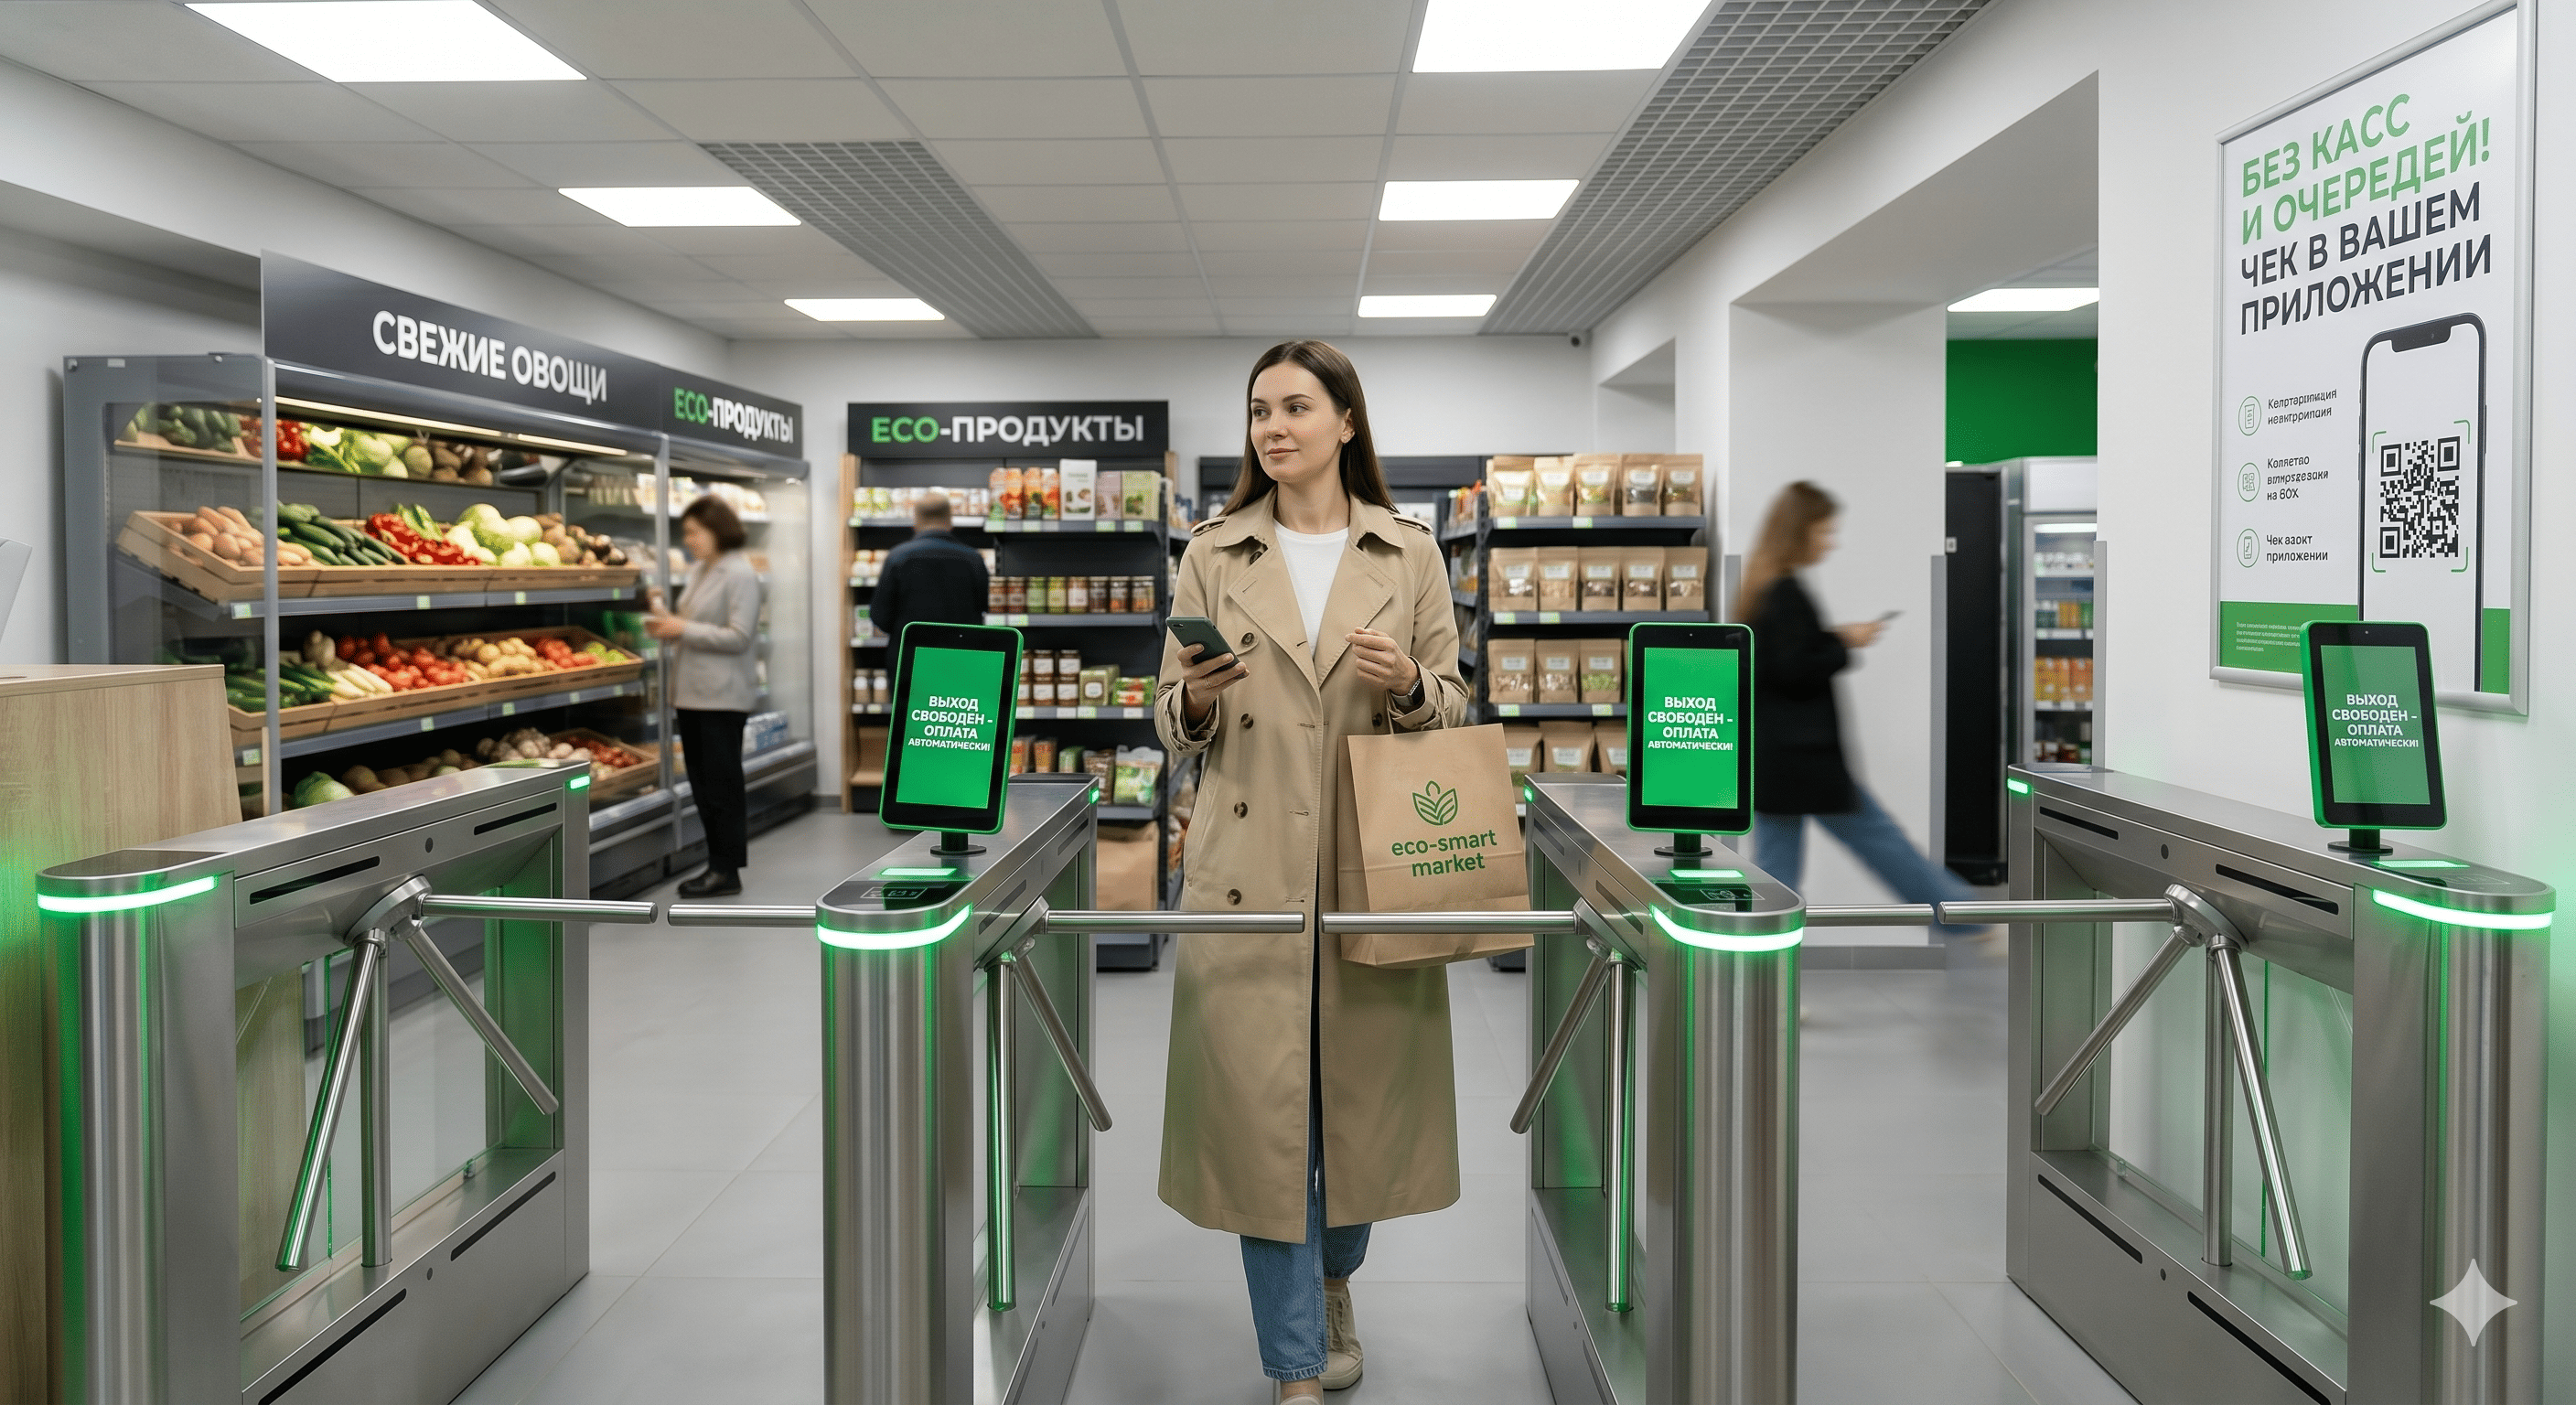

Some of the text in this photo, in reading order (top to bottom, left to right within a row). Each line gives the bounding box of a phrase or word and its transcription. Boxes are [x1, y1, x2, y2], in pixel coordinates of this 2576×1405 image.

[2243, 93, 2410, 198] БЕЗ КАСС
[2242, 110, 2491, 245] И ОЧЕРЕДЕЙ!
[2241, 181, 2480, 288] ЧЕК В ВАШЕМ
[2241, 234, 2492, 336] ПРИЛОЖЕНИИ
[372, 310, 607, 405] СВЕЖИЕ ОВОЩИ
[2266, 534, 2283, 545] Чек
[2266, 552, 2328, 563] приложении
[928, 696, 979, 712] ВЫХОД
[1664, 696, 1716, 711] ВЫХОД
[2346, 693, 2399, 708] ВЫХОД
[911, 709, 985, 725] СВОБОДЕН
[1648, 711, 1724, 725] СВОБОДЕН
[2332, 709, 2408, 723] СВОБОДЕН
[924, 724, 978, 739] ОПЛАТА
[1662, 726, 1719, 739] ОПЛАТА
[2347, 724, 2403, 735] ОПЛАТА
[1391, 830, 1497, 856] eco-smart
[1411, 853, 1486, 877] market
